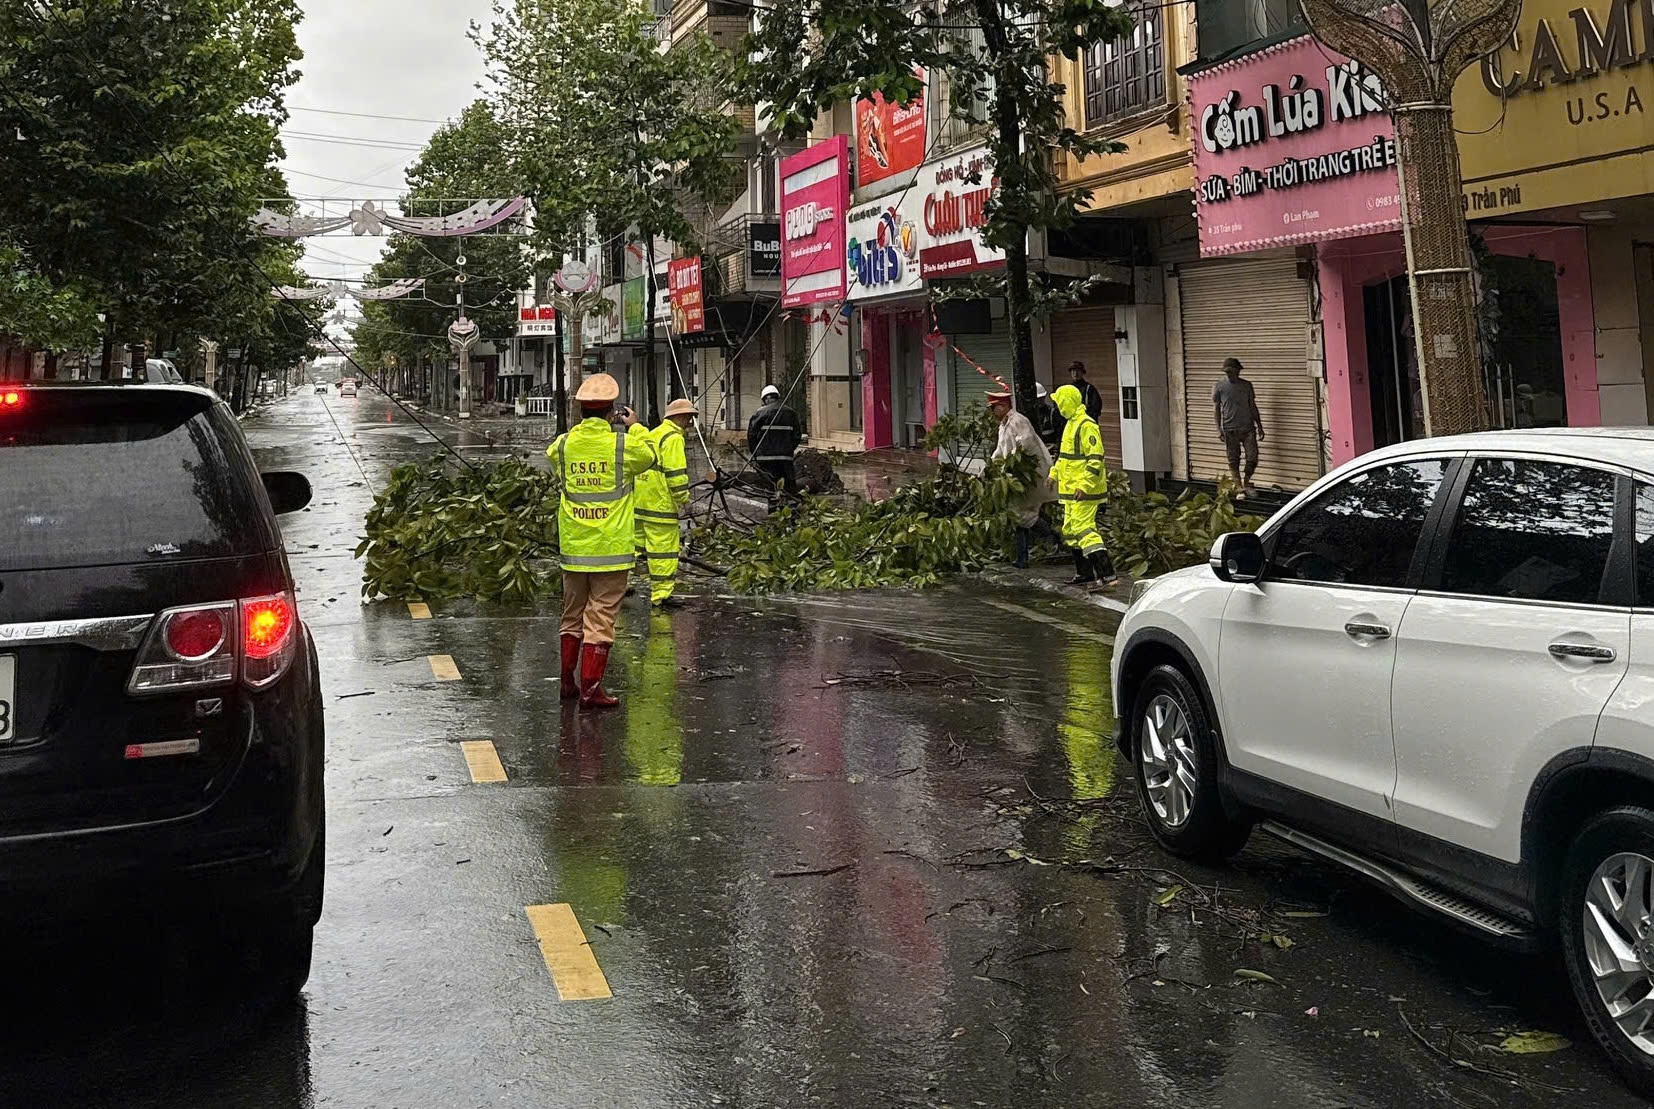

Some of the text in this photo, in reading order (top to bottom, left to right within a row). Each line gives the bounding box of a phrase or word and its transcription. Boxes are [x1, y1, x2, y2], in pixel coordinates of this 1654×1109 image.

[1480, 0, 1654, 97] CAM
[1263, 74, 1320, 137] Lúa
[1566, 86, 1643, 125] U.S.A
[1201, 176, 1225, 202] SỮA
[1232, 168, 1257, 196] BỈM
[1265, 158, 1298, 189] THỜI
[1299, 151, 1350, 182] TRANG
[1352, 137, 1382, 171] TRẺ
[1471, 186, 1497, 210] Trần
[1499, 183, 1521, 206] Phú
[754, 240, 781, 251] BuB
[572, 507, 609, 520] POLICE
